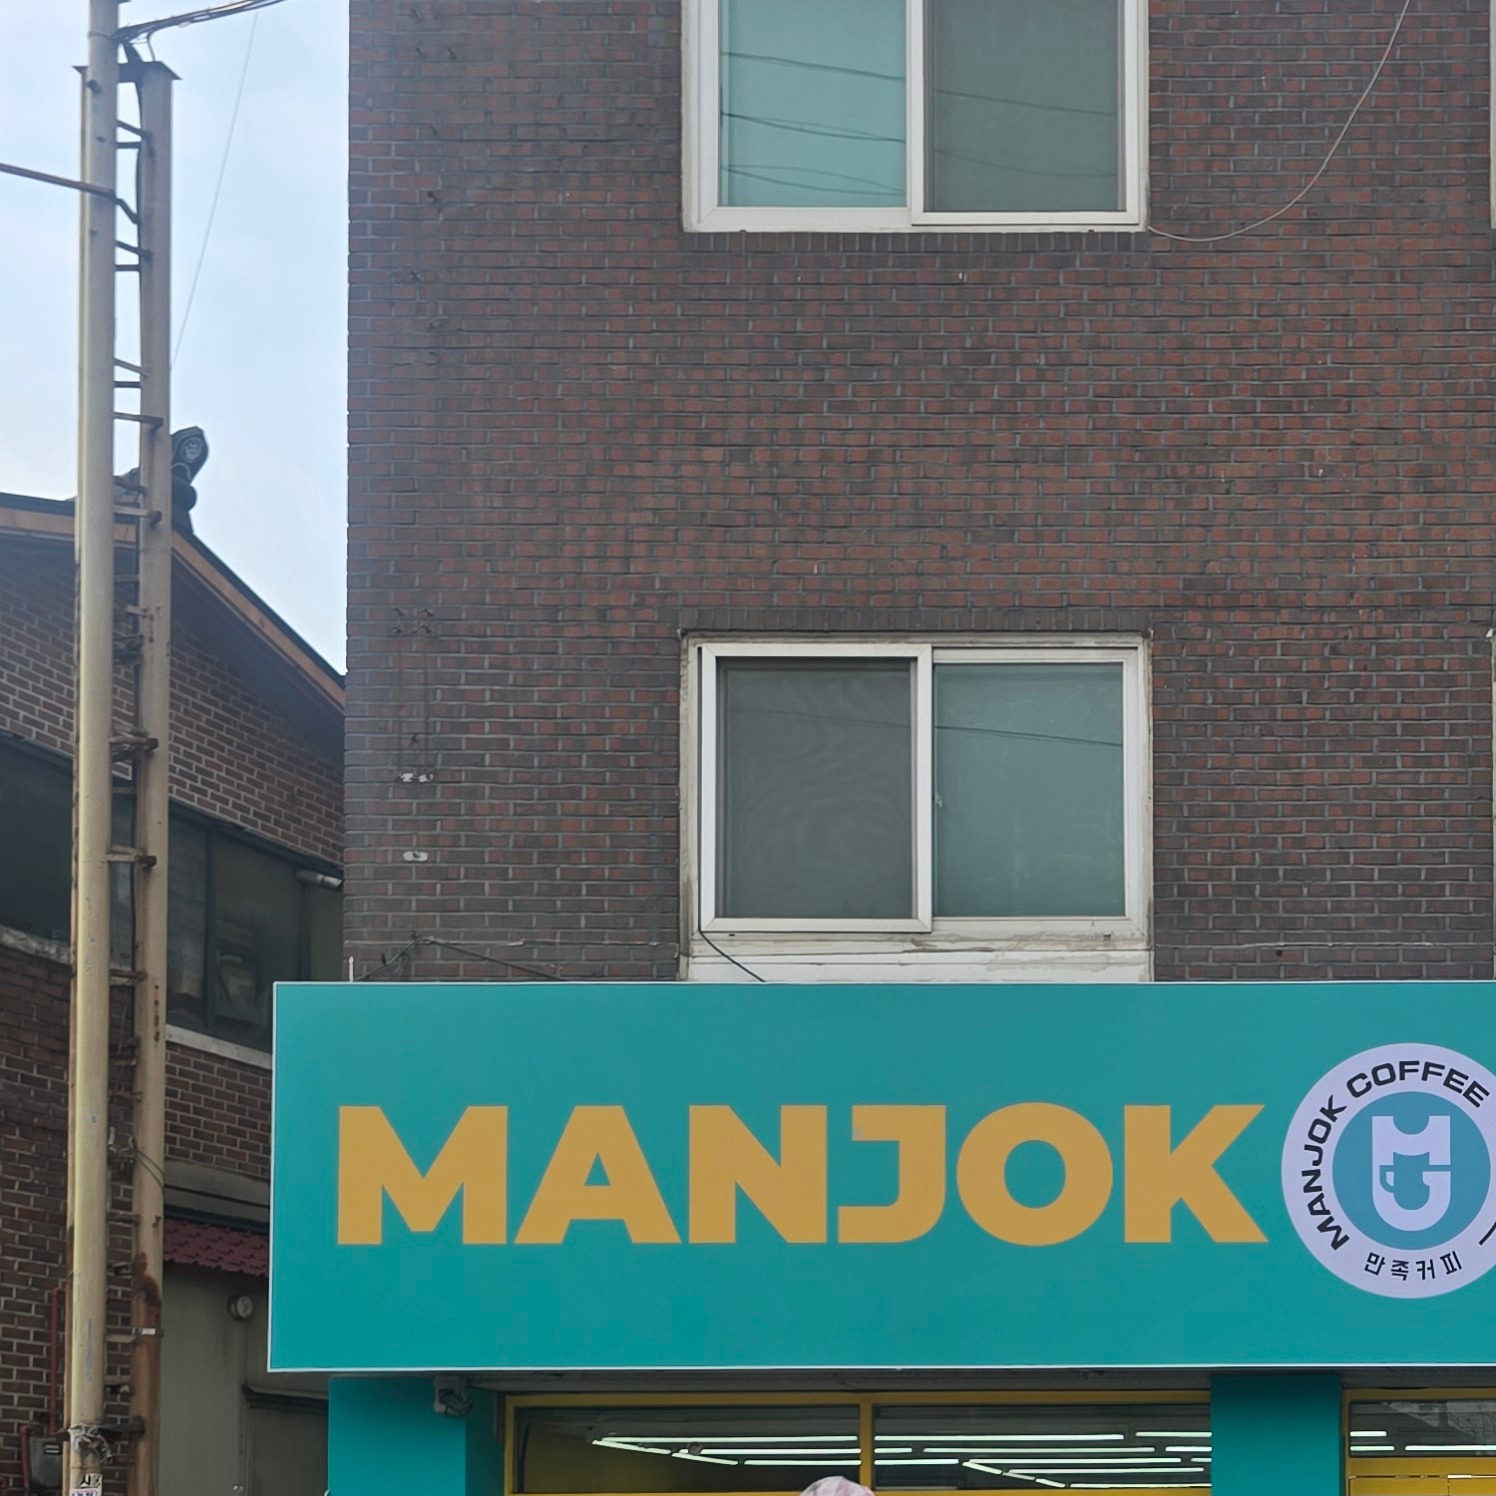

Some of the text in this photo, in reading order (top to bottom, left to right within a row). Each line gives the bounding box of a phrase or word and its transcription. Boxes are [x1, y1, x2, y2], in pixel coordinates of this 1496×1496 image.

[337, 1104, 1268, 1246] MANJOK
[1301, 1060, 1490, 1251] MANJOK COFFEE
[1364, 1251, 1463, 1281] 만족커피
